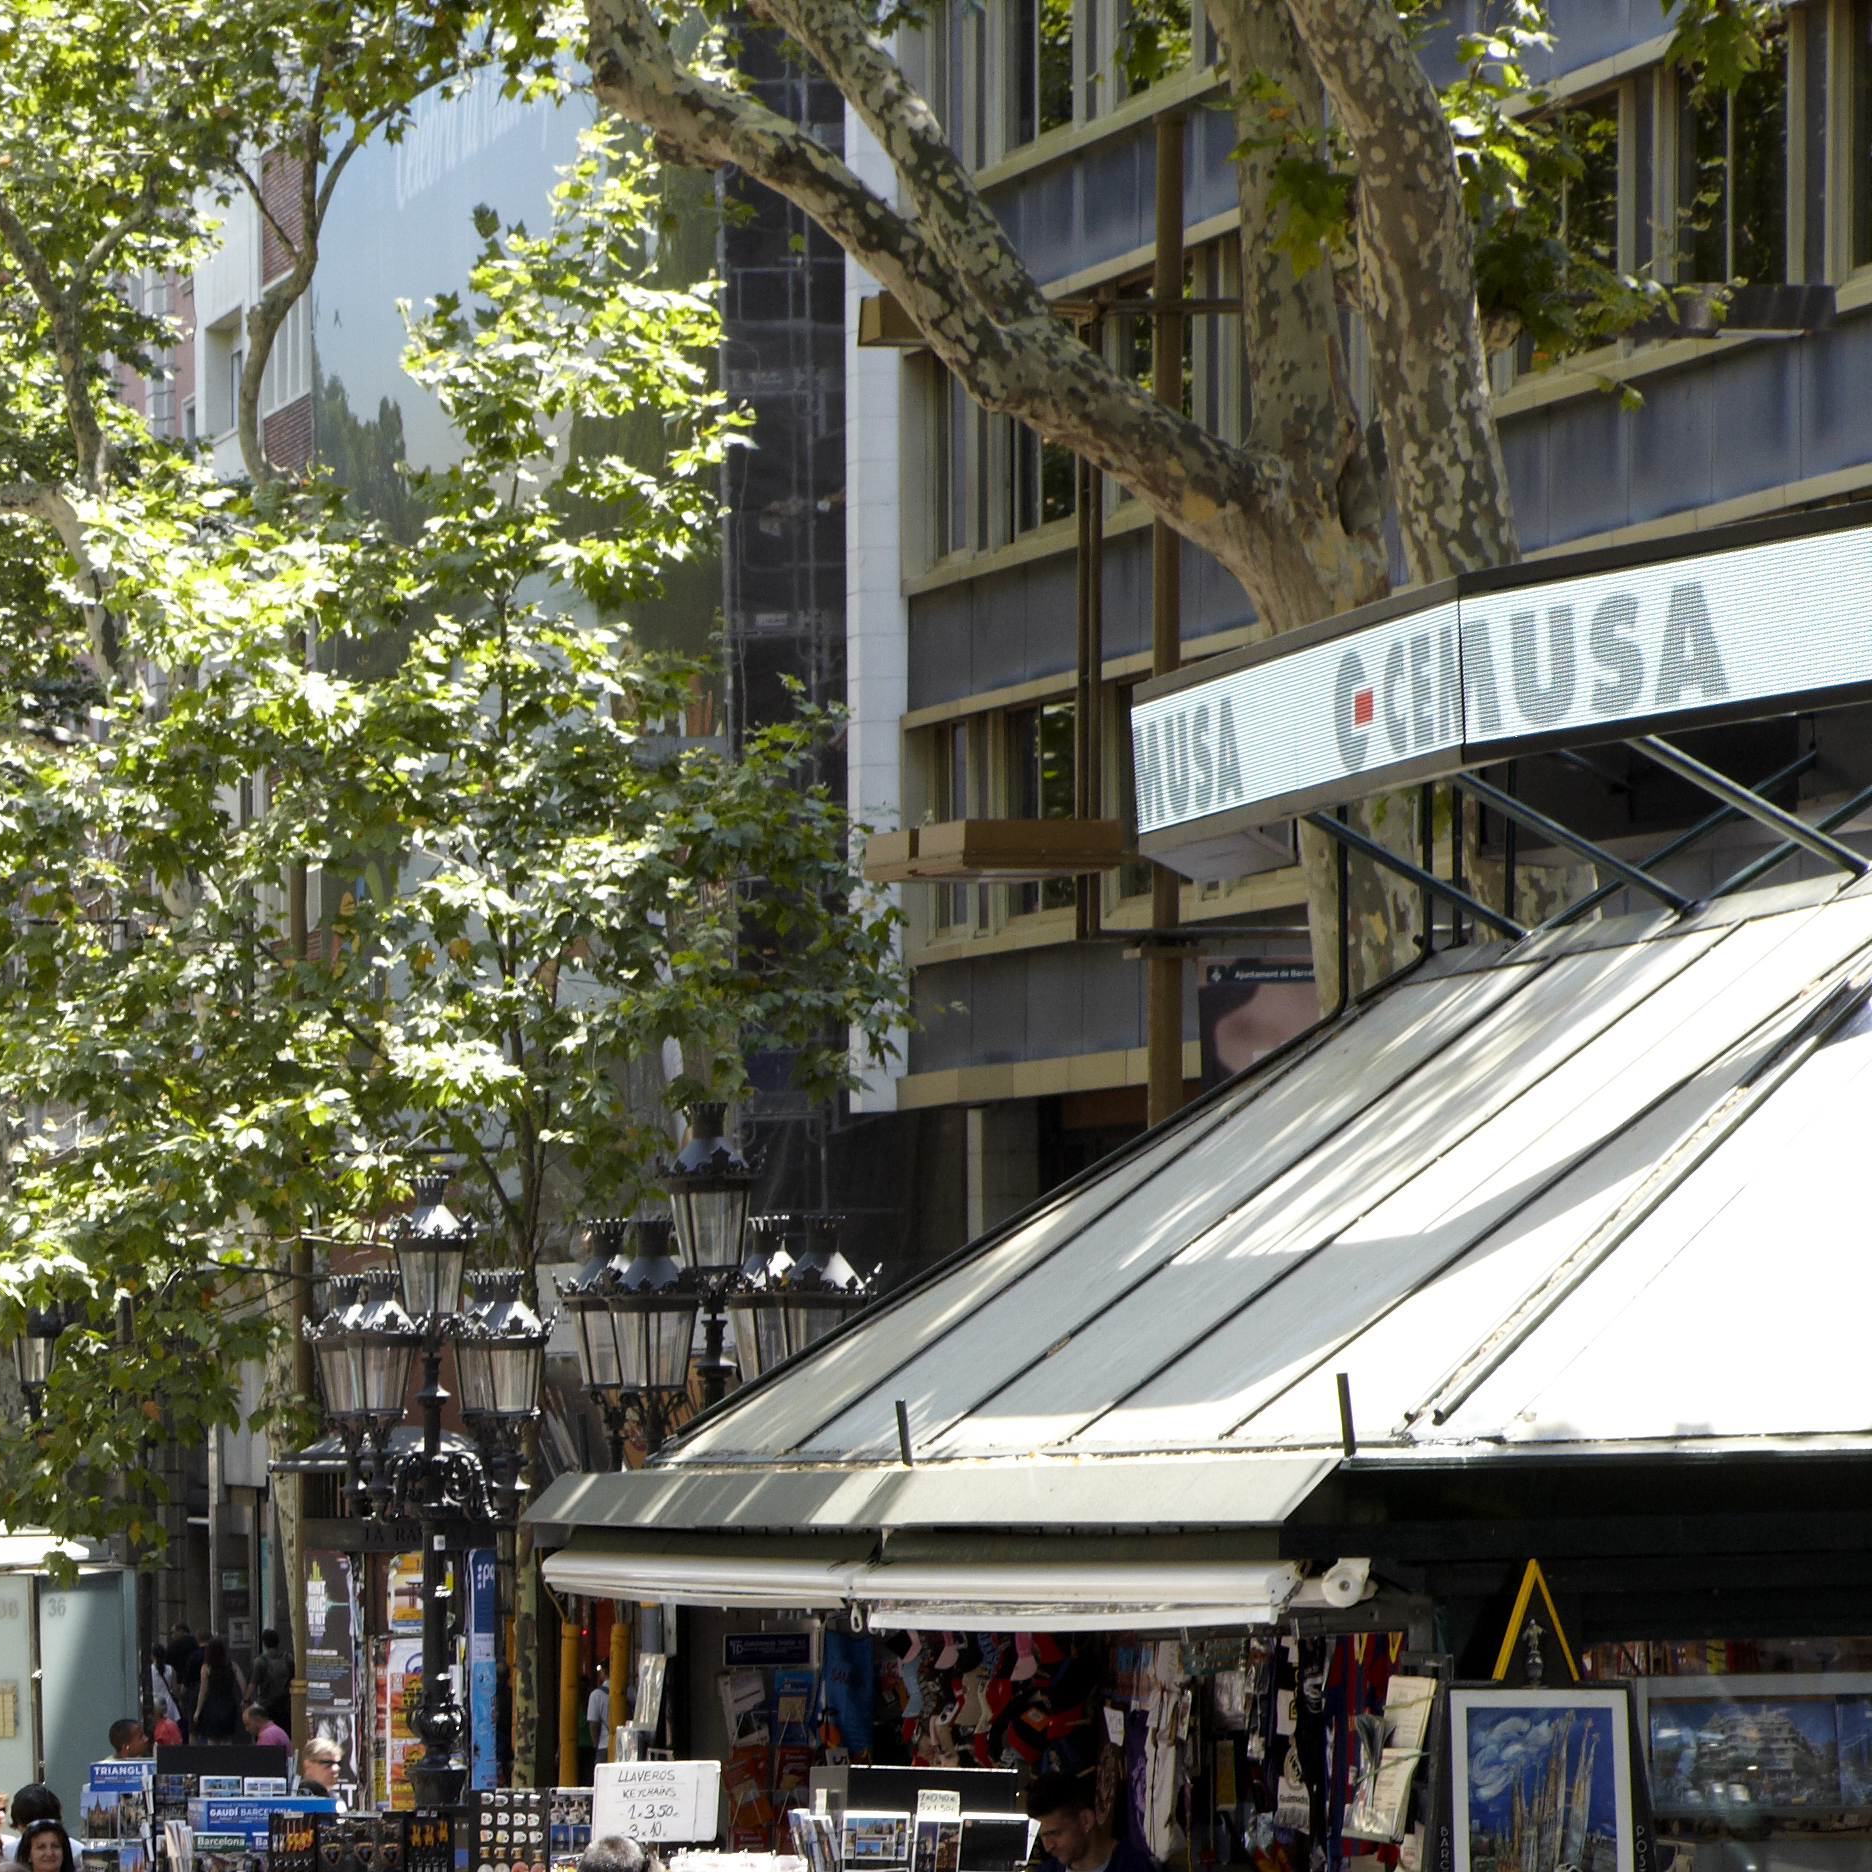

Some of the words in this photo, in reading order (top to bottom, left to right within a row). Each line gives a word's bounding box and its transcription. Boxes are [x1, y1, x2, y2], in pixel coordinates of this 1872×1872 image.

[1383, 582, 1730, 755] CEMUSA
[47, 1597, 67, 1618] 36
[94, 1766, 143, 1776] TRIANGL
[617, 1769, 676, 1783] LLAVEROS
[197, 1836, 246, 1847] Barcelona
